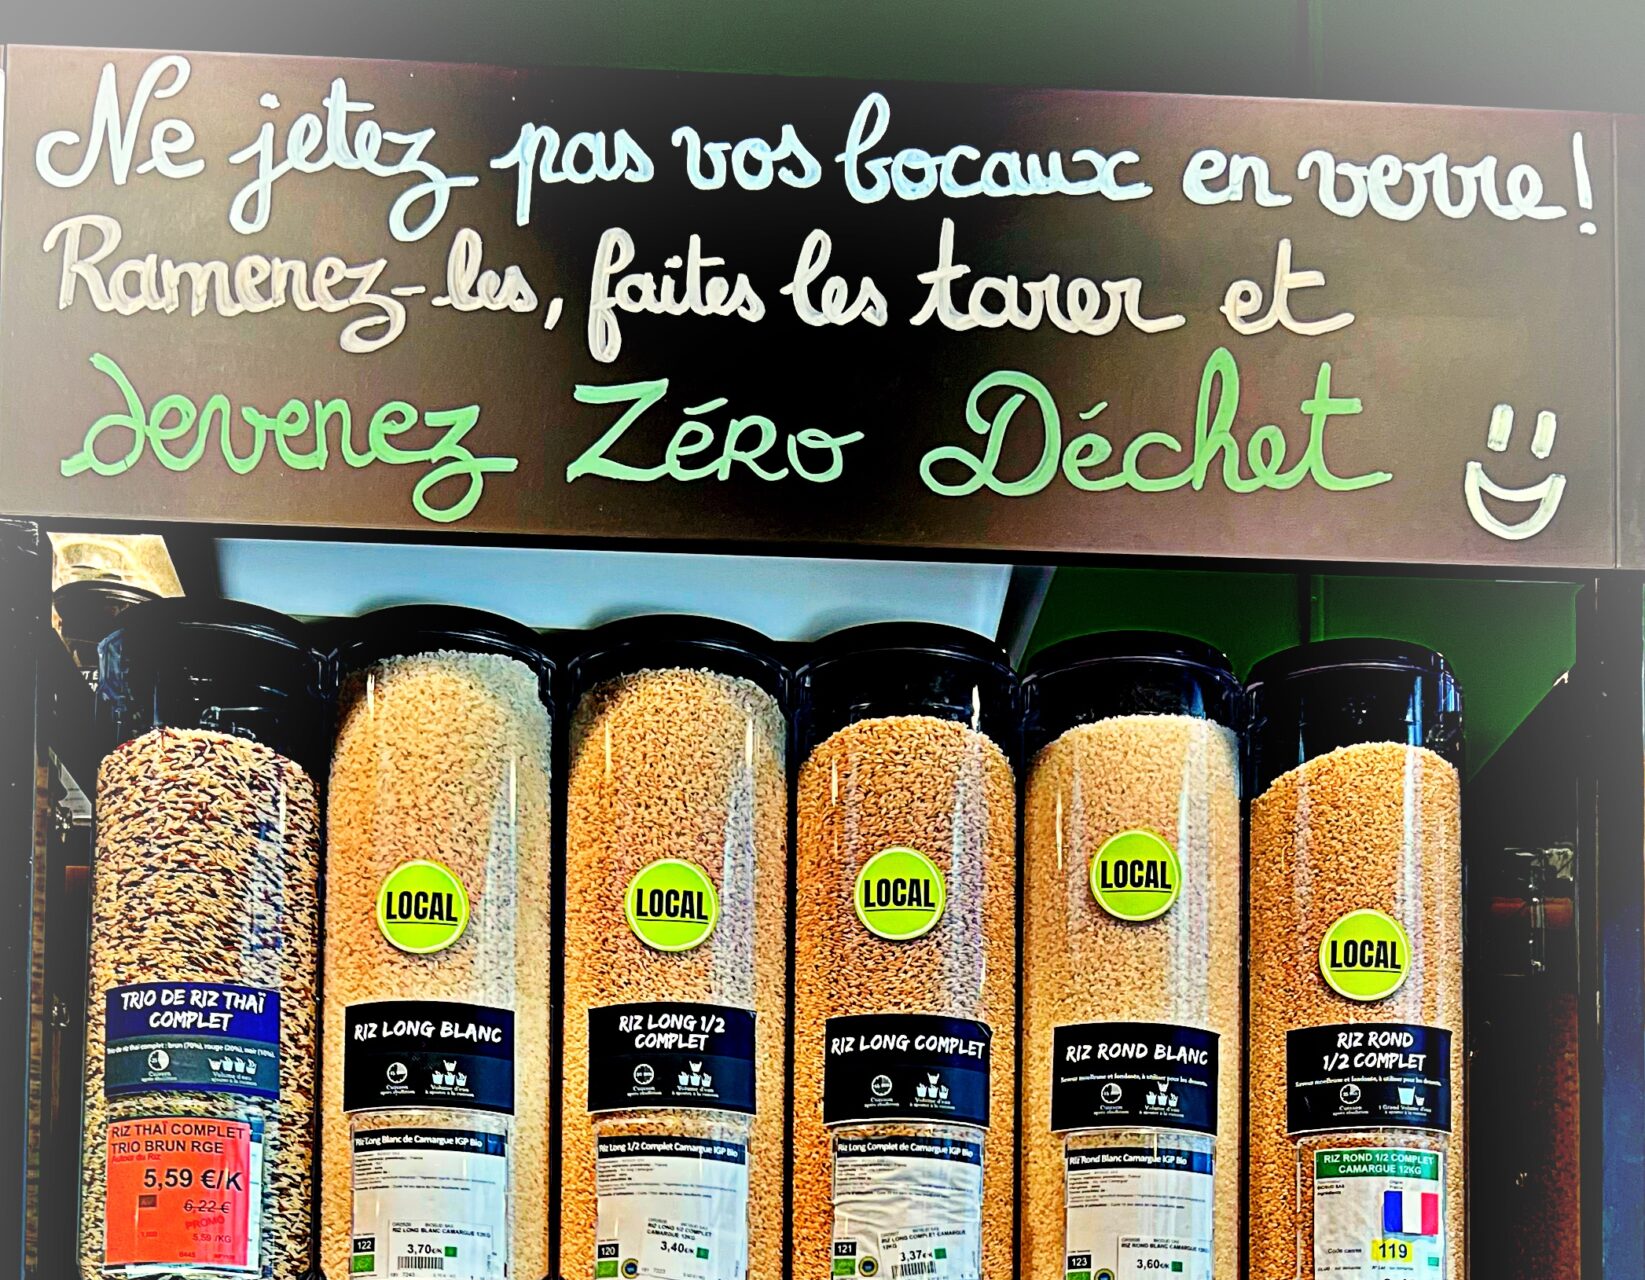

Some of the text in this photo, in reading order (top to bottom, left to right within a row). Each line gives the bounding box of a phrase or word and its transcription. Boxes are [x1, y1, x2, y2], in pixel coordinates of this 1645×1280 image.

[36, 54, 204, 187] Ne
[228, 77, 479, 242] jetez
[490, 122, 654, 226] pas
[672, 123, 821, 191] vos
[835, 91, 1154, 204] bocaux
[1182, 149, 1292, 206] en
[588, 227, 767, 363] faites
[779, 228, 888, 327] les
[909, 217, 1186, 336] tarer
[1219, 238, 1355, 335] et
[918, 346, 1394, 497] Déchet
[1101, 860, 1171, 889] LOCAL
[864, 878, 935, 908] LOCAL
[386, 891, 458, 922] LOCAL
[637, 889, 709, 920] LOCAL
[1330, 940, 1401, 970] LOCAL
[121, 989, 267, 1014] TRIO DE RIZ THAÏ
[149, 1011, 234, 1031] COMPLET
[619, 1014, 725, 1034] RIZ LONG 1/2
[354, 1020, 502, 1043] RIZ LONG BLANC
[1337, 1031, 1414, 1049] RIZ ROND
[635, 1033, 709, 1051] COMPLET
[831, 1034, 986, 1059] RIZ LONG COMPLET
[1065, 1043, 1209, 1066] RIZ ROND BLANC
[1323, 1052, 1427, 1072] 1/2 COMPLET
[112, 1121, 245, 1140] RIZ THAÏ COMPLET
[112, 1140, 224, 1155] TRIO BRUN RGE
[365, 1136, 381, 1146] Long
[382, 1135, 402, 1144] Blanc
[403, 1135, 413, 1144] de
[414, 1135, 454, 1146] Camargue
[470, 1138, 483, 1148] Bio
[610, 1143, 626, 1153] Long
[628, 1142, 640, 1151] 1/2
[642, 1142, 673, 1152] Complet
[674, 1143, 712, 1155] Camargue
[849, 1144, 866, 1153] Long
[868, 1142, 898, 1152] Complet
[910, 1144, 948, 1155] Camargue
[1081, 1154, 1100, 1164] Rond
[1101, 1154, 1122, 1163] Blanc
[1123, 1153, 1162, 1164] Camargue
[1176, 1156, 1188, 1165] Bio
[1323, 1153, 1434, 1165] RIZ ROND 1/2 COMPLET
[1338, 1164, 1422, 1175] CAMARGUE 12KG
[143, 1168, 193, 1191] 5,59
[184, 1199, 232, 1214] 6,22 €
[185, 1214, 225, 1231] PROMO
[357, 1241, 372, 1250] 122
[601, 1246, 616, 1256] 120
[837, 1245, 852, 1253] 121
[1378, 1243, 1408, 1259] 119
[1071, 1258, 1088, 1267] 123
